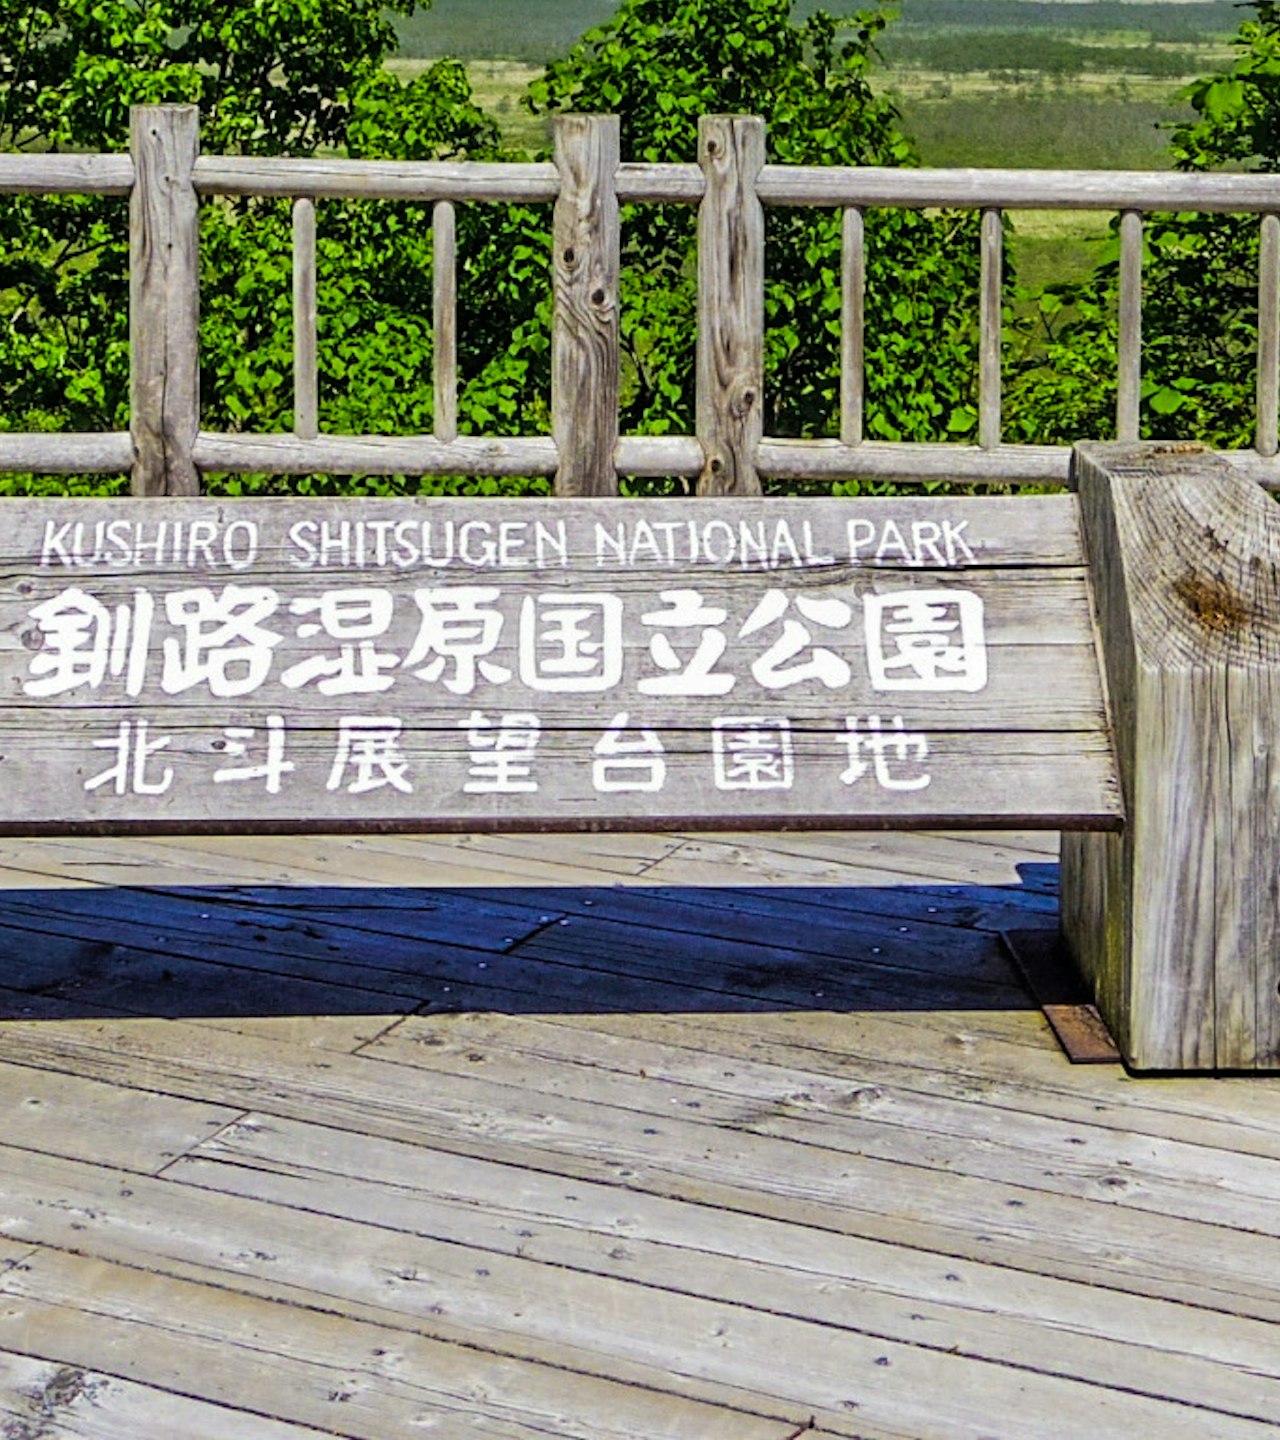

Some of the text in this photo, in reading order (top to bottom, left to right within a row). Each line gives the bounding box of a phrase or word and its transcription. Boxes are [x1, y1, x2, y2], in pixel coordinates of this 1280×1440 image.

[42, 518, 979, 570] KUSHIRO SHITSUGEN NATIONAL PARK
[23, 585, 988, 697] 釧路湿原国立公園
[84, 711, 931, 794] 北斗展望台園地
